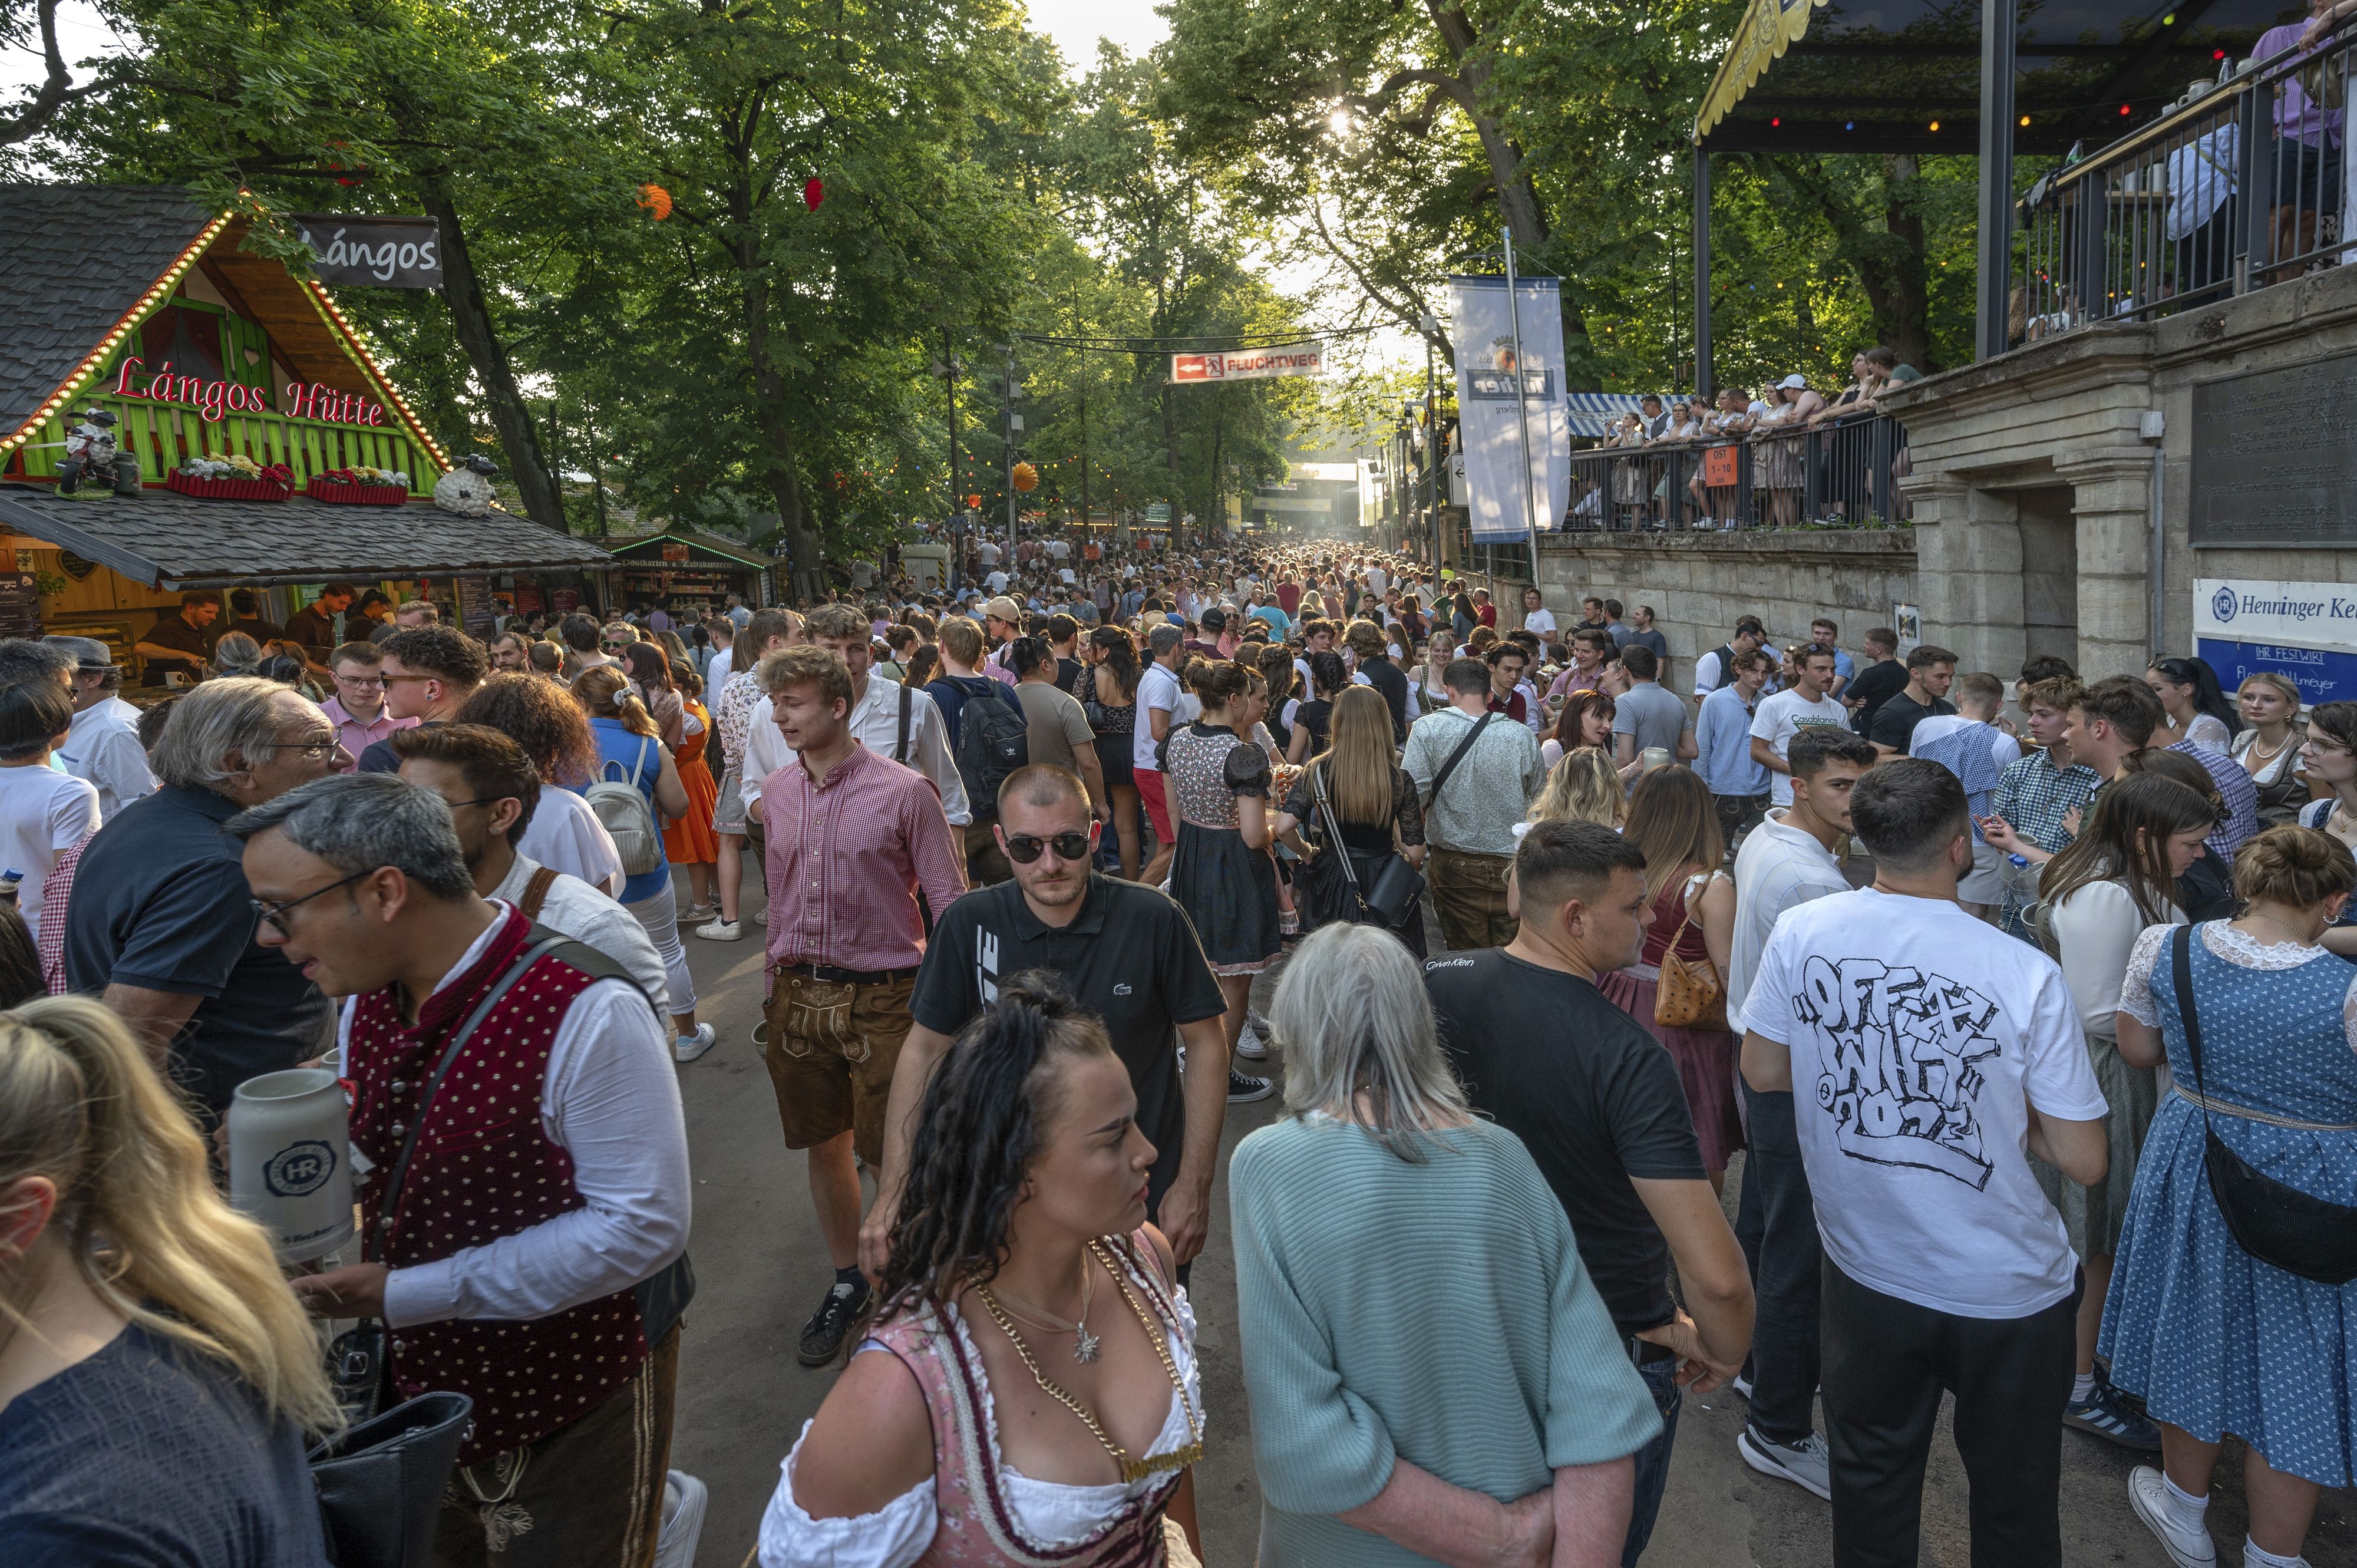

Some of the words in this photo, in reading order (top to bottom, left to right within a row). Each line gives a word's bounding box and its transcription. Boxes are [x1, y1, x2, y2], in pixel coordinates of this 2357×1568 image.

[1227, 354, 1318, 371] FLUCHTWEG
[112, 356, 267, 422] Lángos
[285, 382, 384, 427] Hütte
[1714, 449, 1727, 459] OST
[1712, 465, 1715, 474] 1
[1722, 463, 1731, 473] 10
[622, 559, 668, 567] Postkarten
[682, 560, 732, 568] Tabakwaren
[2217, 599, 2230, 610] HR
[2242, 595, 2325, 621] Henninger
[2256, 646, 2270, 658] IHR
[2276, 648, 2326, 663] FESTWIRT
[1791, 714, 1837, 724] Casablanca
[1426, 959, 1451, 970] Cavin
[1451, 957, 1474, 966] Klein
[286, 1158, 319, 1180] HR
